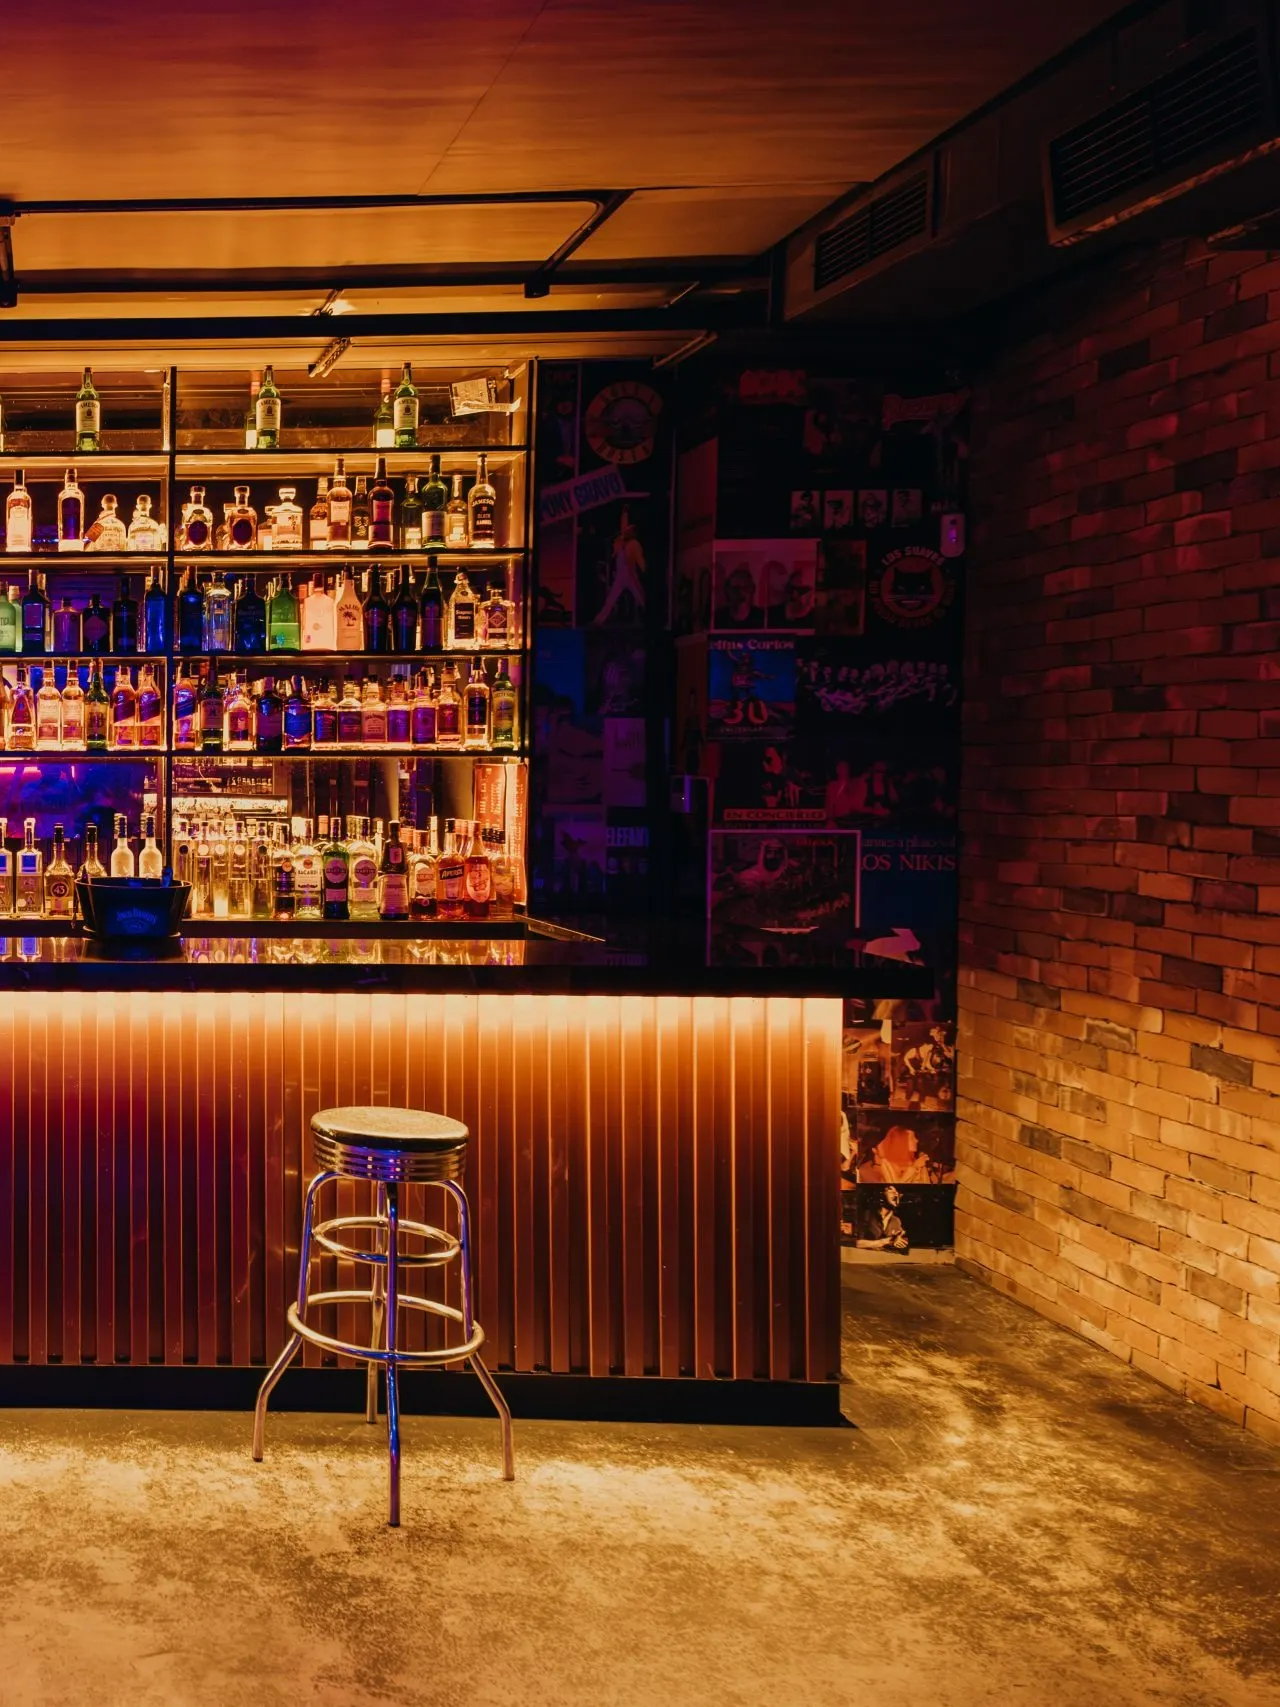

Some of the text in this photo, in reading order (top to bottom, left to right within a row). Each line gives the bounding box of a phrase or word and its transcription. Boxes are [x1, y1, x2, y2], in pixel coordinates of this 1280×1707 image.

[861, 854, 956, 871] OS NIKIS
[53, 884, 66, 894] 43
